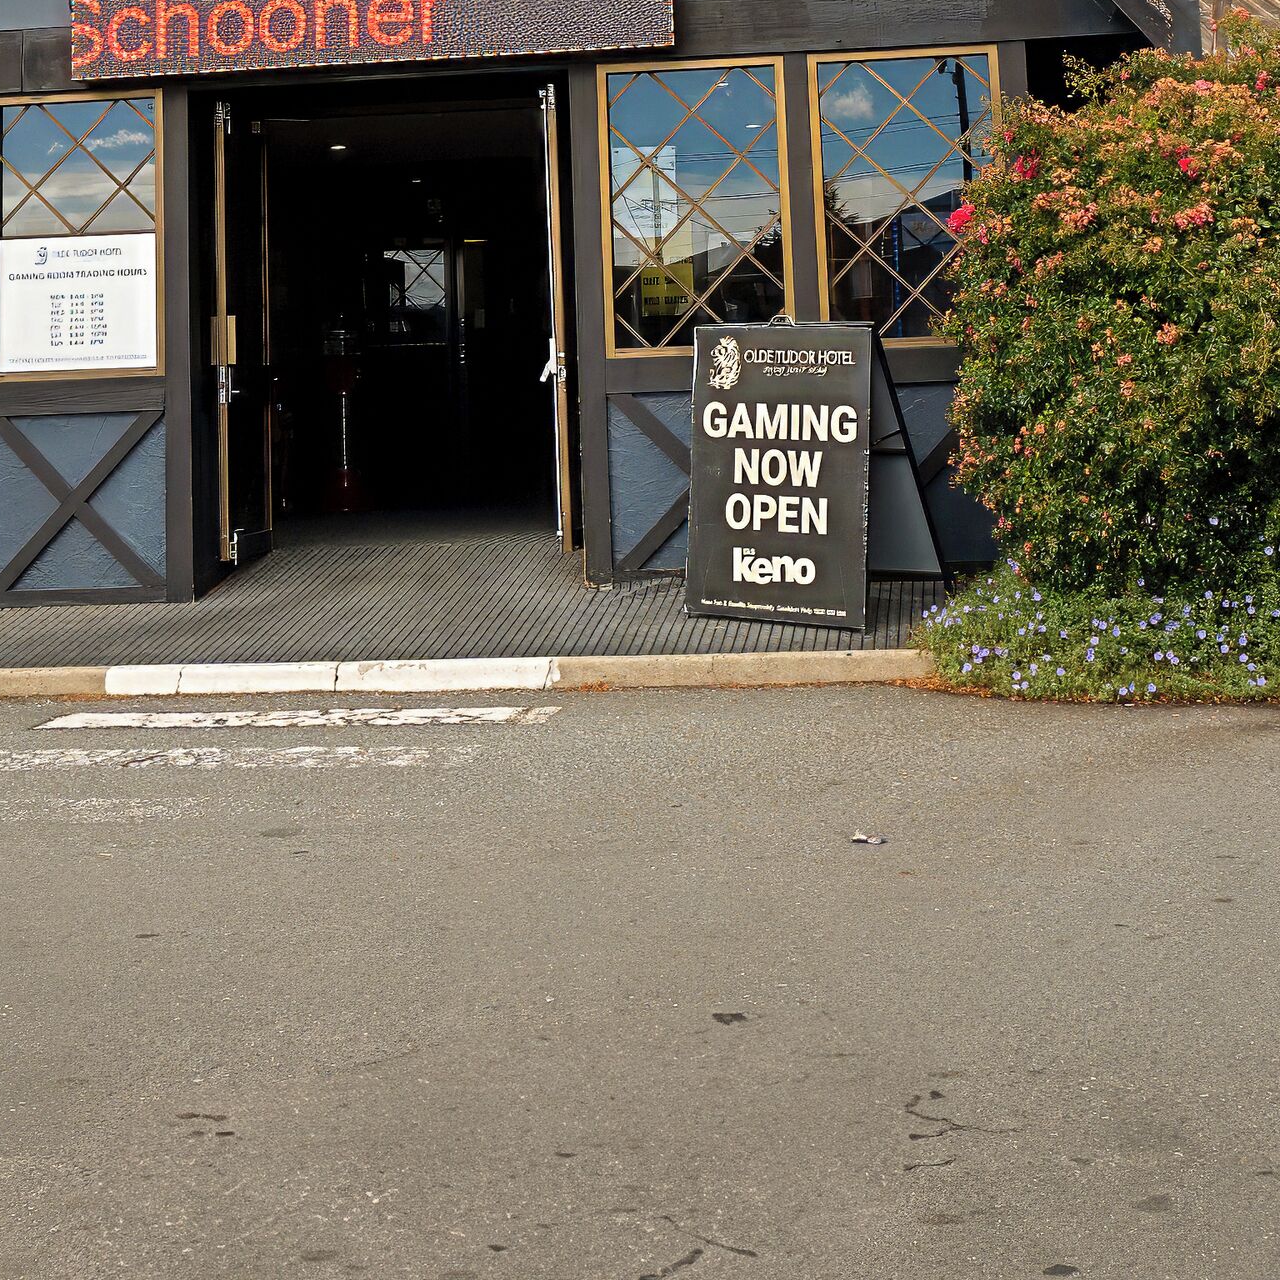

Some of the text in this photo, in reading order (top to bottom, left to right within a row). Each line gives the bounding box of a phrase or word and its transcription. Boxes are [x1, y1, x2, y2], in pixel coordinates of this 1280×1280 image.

[8, 272, 45, 281] GAMING
[743, 349, 856, 365] OLDE TUDOR HOTEL
[702, 401, 858, 444] GAMING
[733, 447, 823, 489] NOW
[725, 492, 828, 536] OPEN
[732, 546, 816, 585] keno
